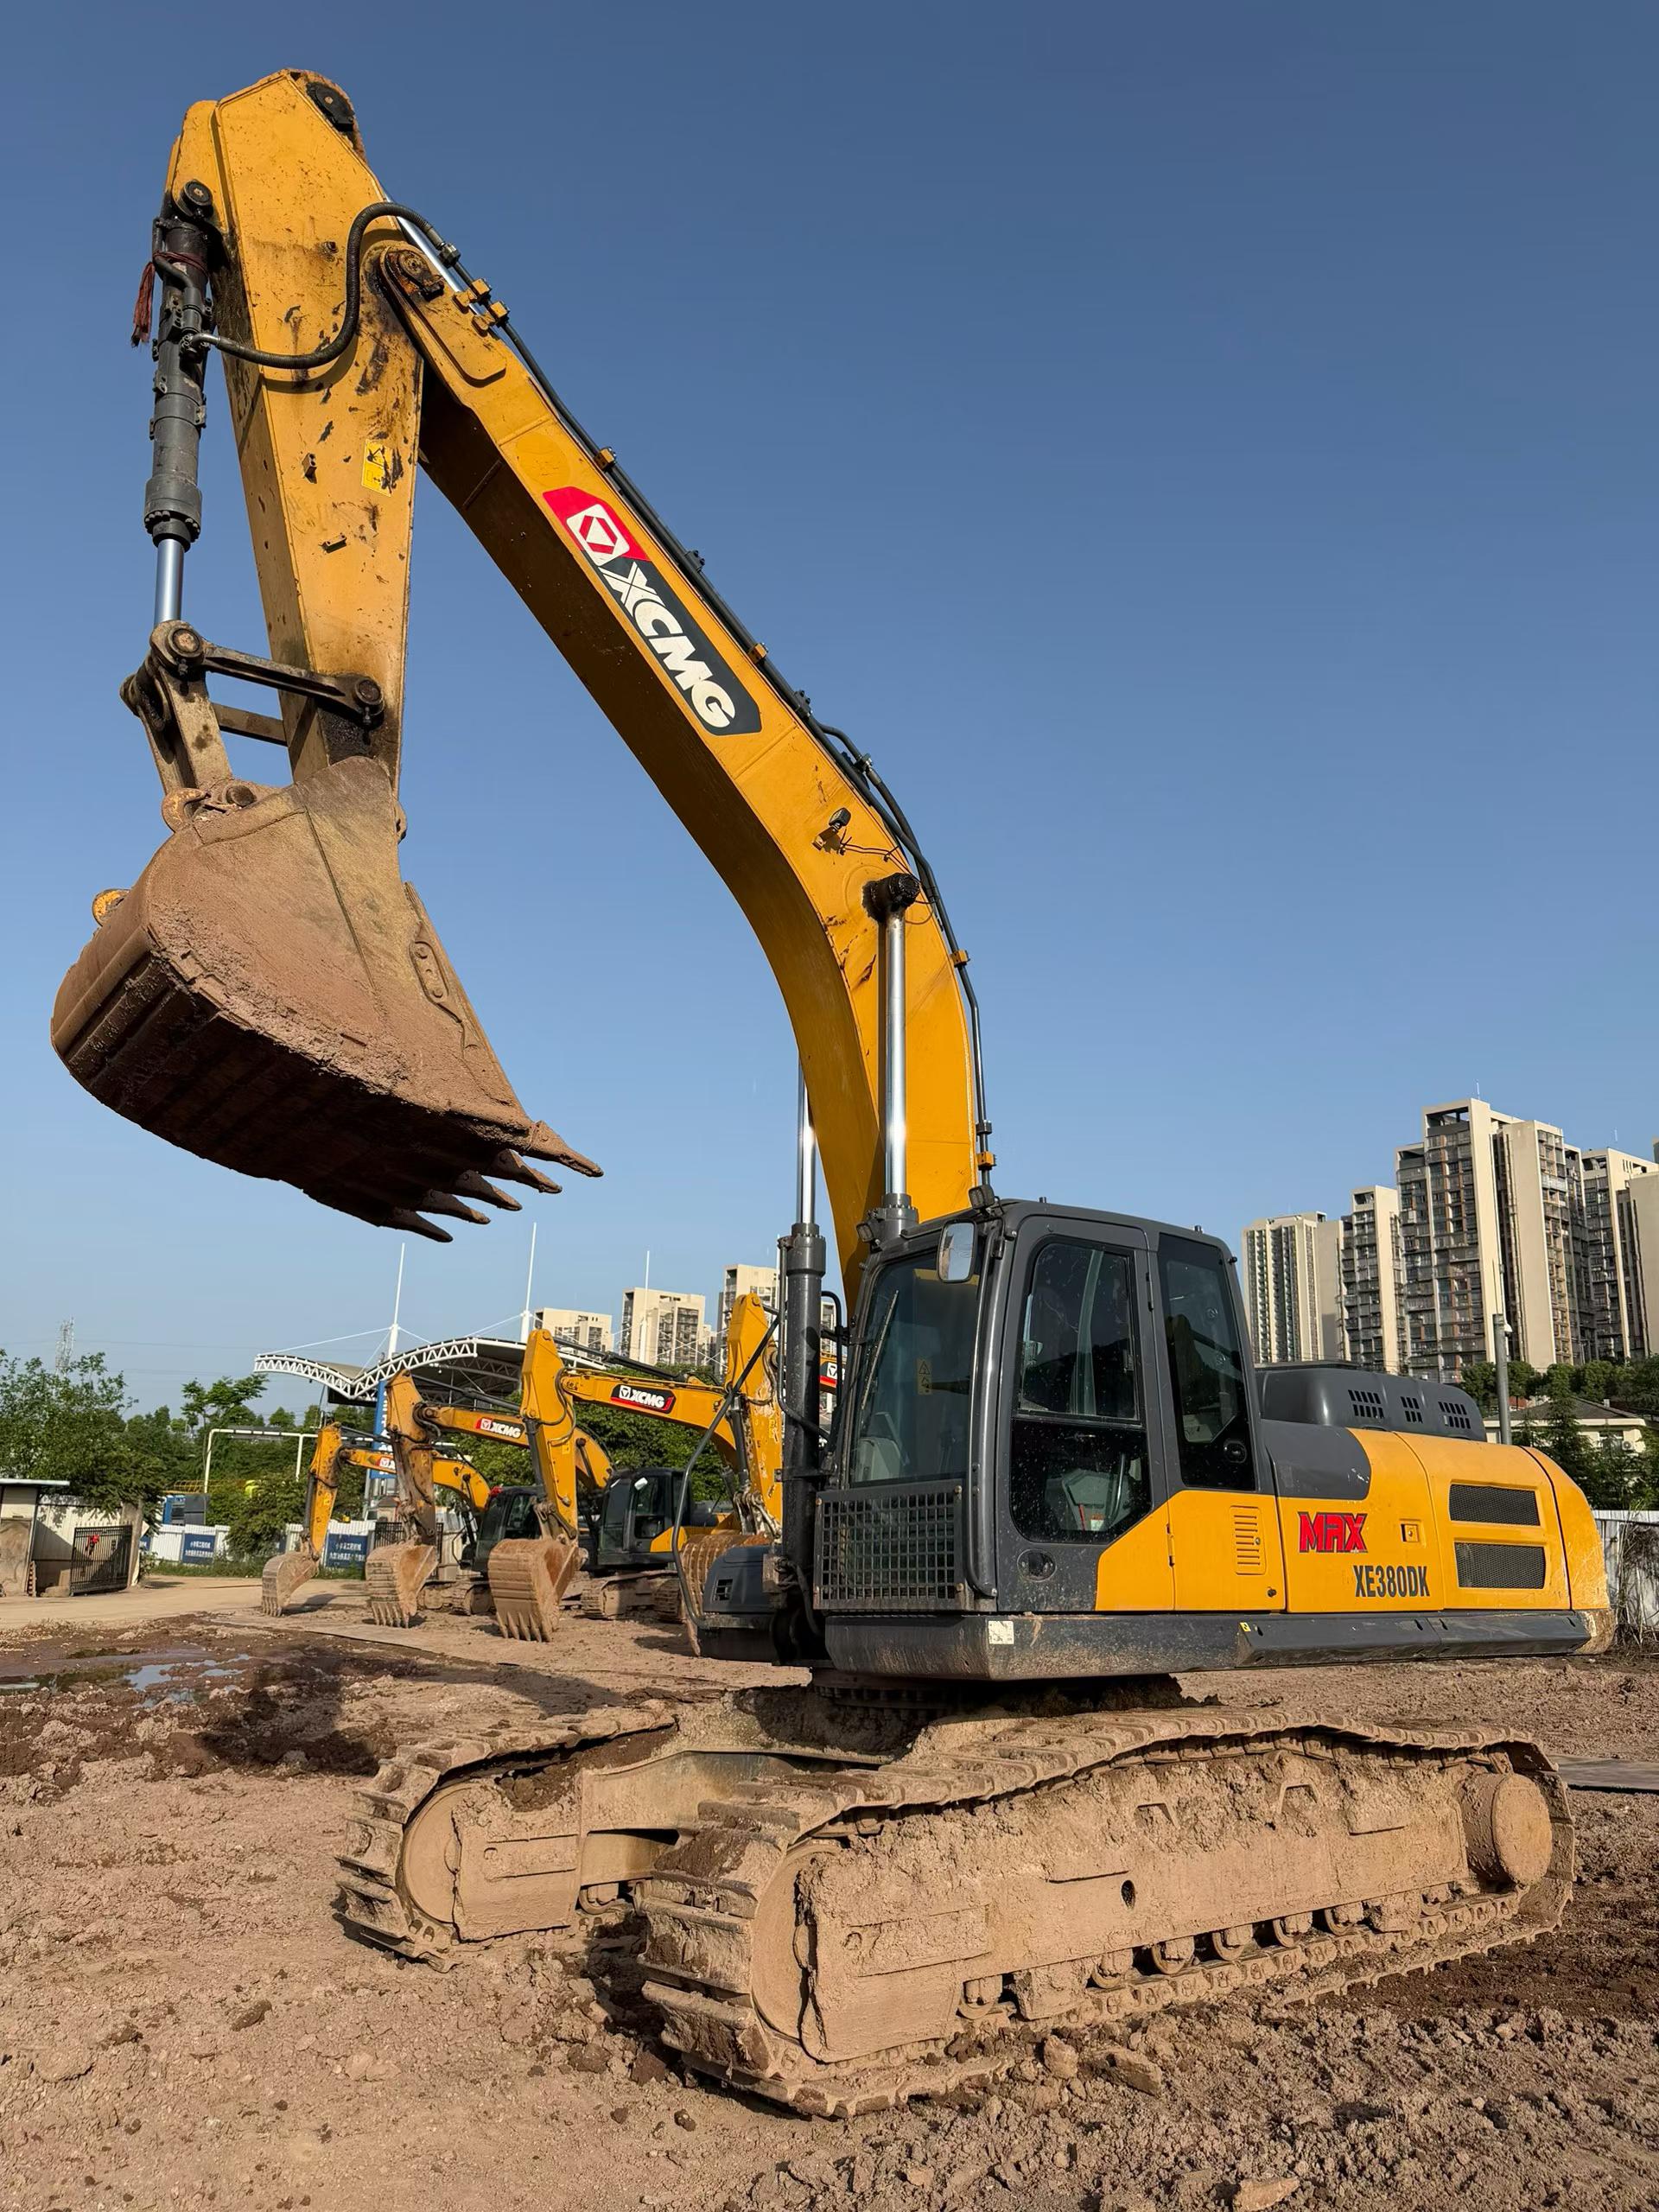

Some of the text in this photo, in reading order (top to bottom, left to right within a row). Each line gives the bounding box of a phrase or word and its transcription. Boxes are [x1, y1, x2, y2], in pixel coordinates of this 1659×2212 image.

[598, 561, 736, 728] XCMG
[630, 1389, 665, 1408] XCMG
[490, 1421, 521, 1439] XCMG
[1298, 1511, 1368, 1553] MAX
[1353, 1565, 1430, 1598] XE380DK
